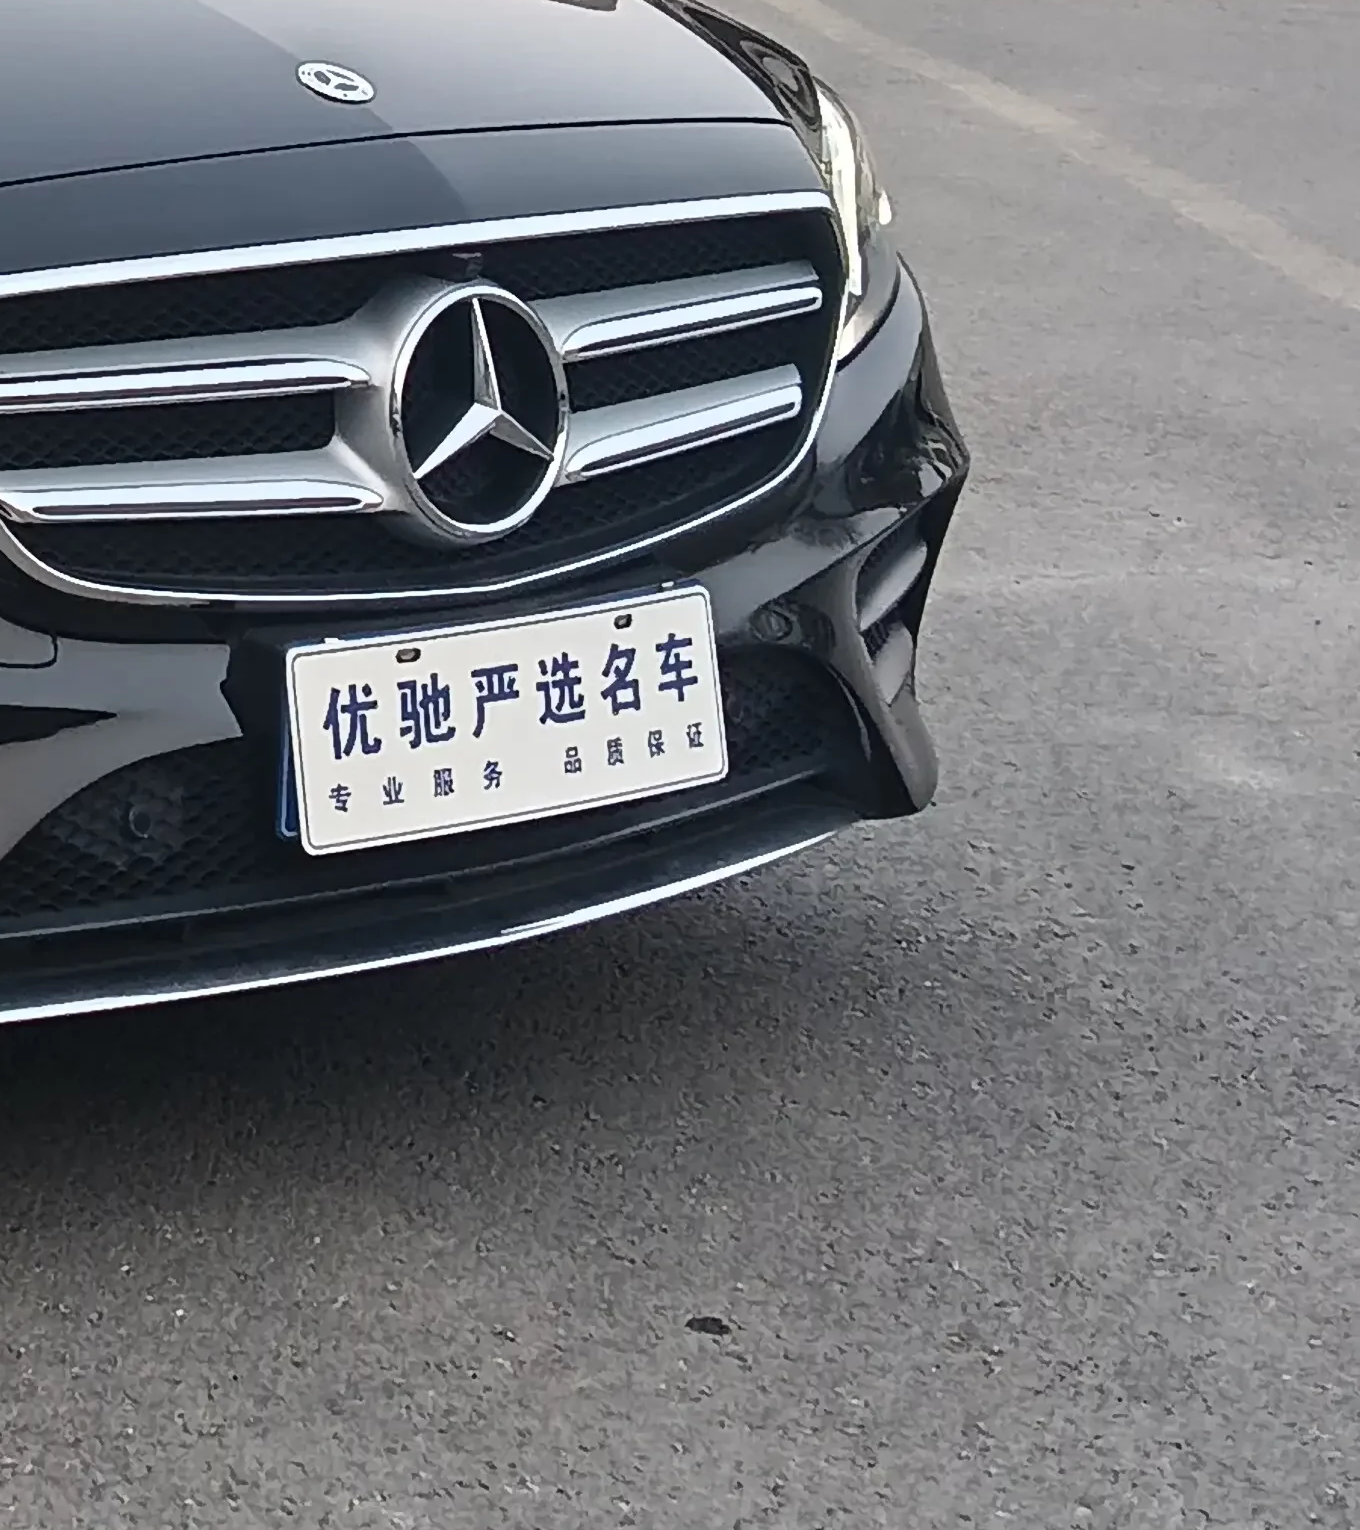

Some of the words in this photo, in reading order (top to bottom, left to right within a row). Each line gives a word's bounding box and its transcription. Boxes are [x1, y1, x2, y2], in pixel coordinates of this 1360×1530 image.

[322, 631, 699, 760] 优驰严选名车
[328, 759, 504, 814] 专业服务
[564, 721, 706, 775] 品质保证
